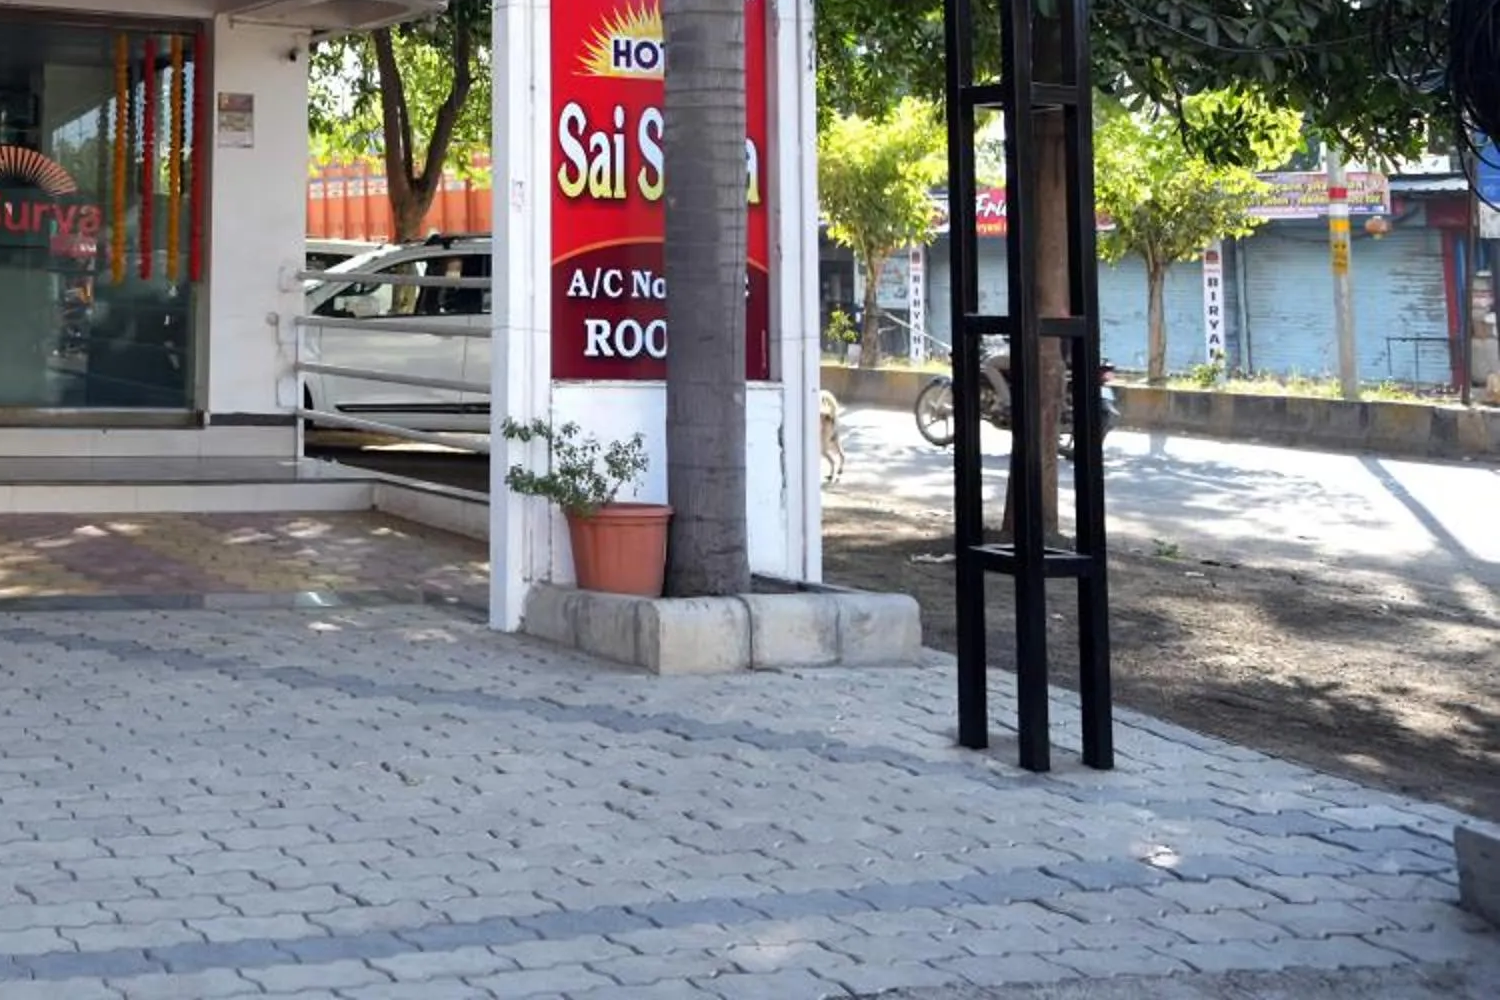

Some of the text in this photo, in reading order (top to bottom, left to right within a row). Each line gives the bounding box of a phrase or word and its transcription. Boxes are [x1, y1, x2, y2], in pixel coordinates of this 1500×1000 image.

[557, 101, 627, 199] Sai
[566, 267, 666, 299] A/C No
[583, 318, 668, 358] ROO
